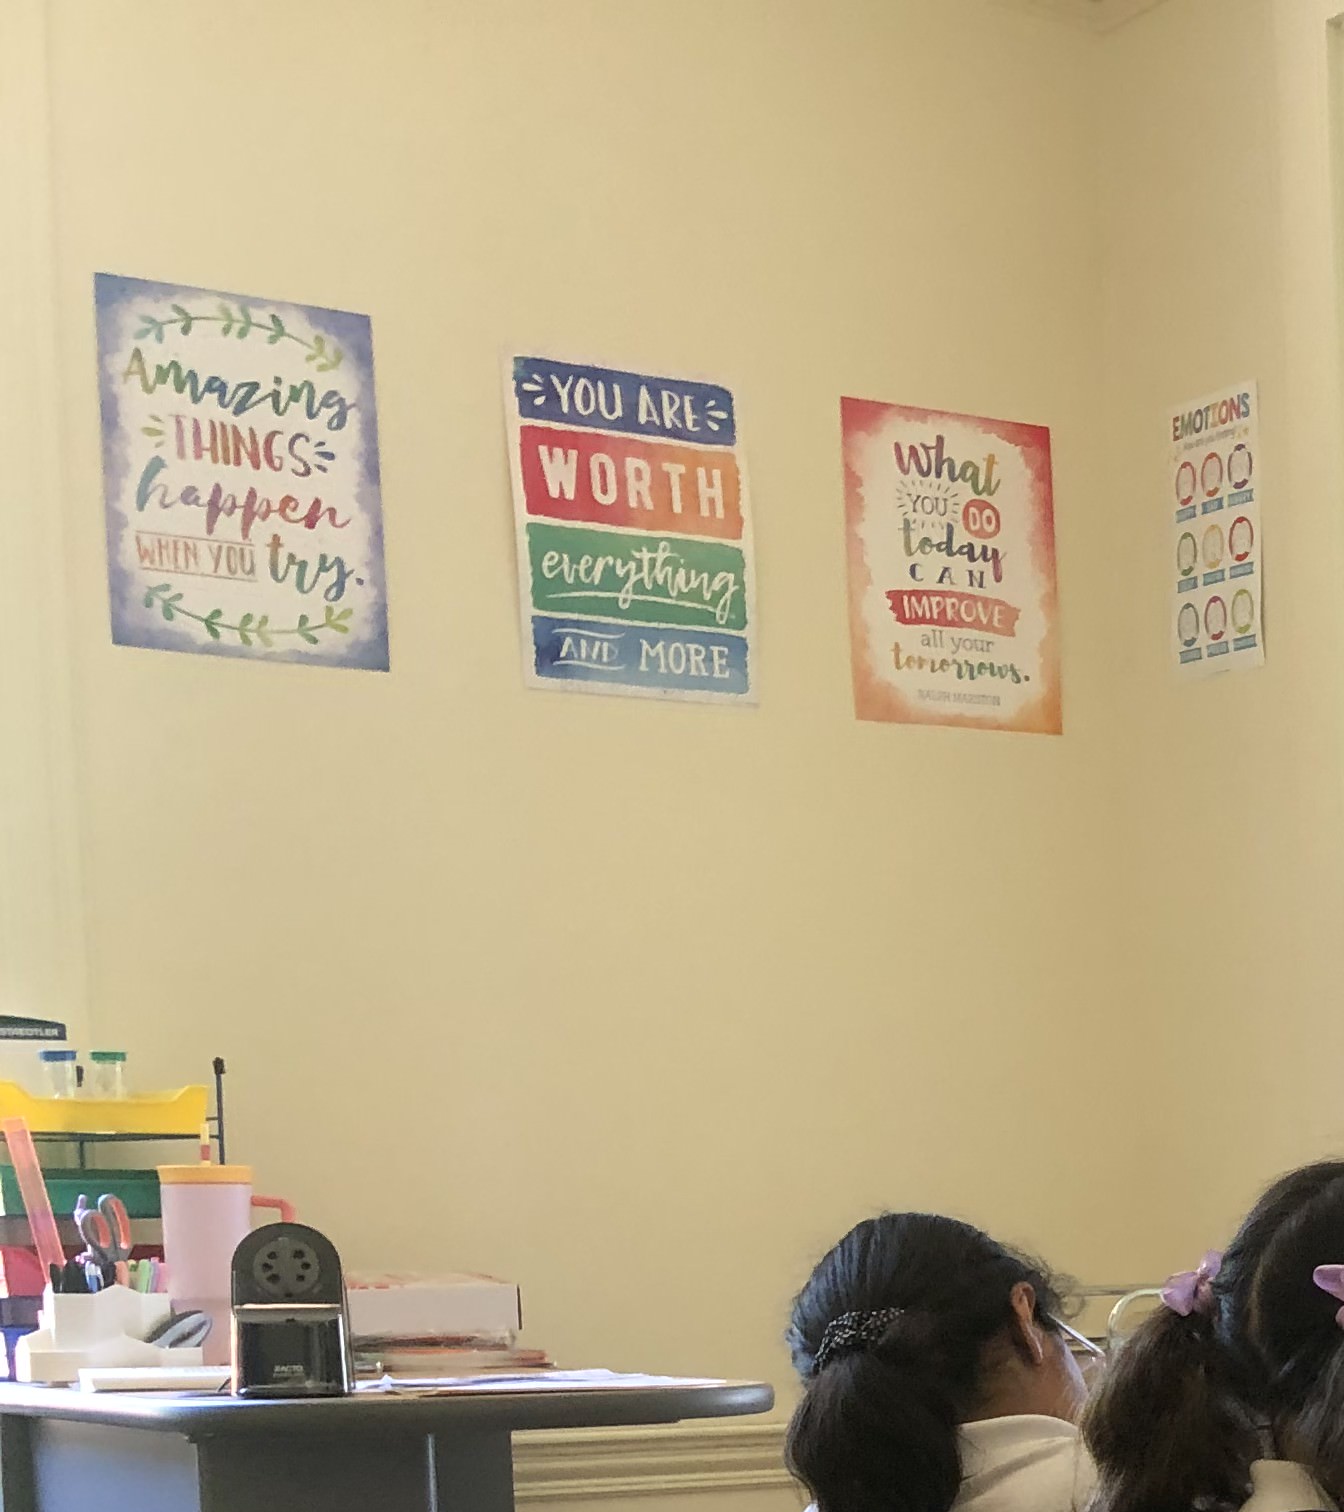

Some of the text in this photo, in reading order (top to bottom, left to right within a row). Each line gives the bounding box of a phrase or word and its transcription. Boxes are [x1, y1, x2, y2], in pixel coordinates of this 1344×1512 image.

[123, 347, 356, 430] Amazing
[551, 374, 700, 431] YOU ARE
[1173, 393, 1250, 441] EMOTIONS
[168, 414, 311, 477] THINGS
[894, 434, 1000, 496] What
[135, 456, 350, 540] happen
[538, 445, 725, 519] WORTH
[910, 494, 996, 532] YOU DO
[136, 534, 365, 601] WHEN YOU try.
[898, 517, 1006, 583] today
[909, 563, 985, 588] CAN
[542, 541, 738, 624] everything
[903, 595, 1003, 627] IMPROVE
[560, 637, 729, 678] AND MORE
[891, 642, 1030, 684] tomorrows.
[921, 631, 994, 654] all your
